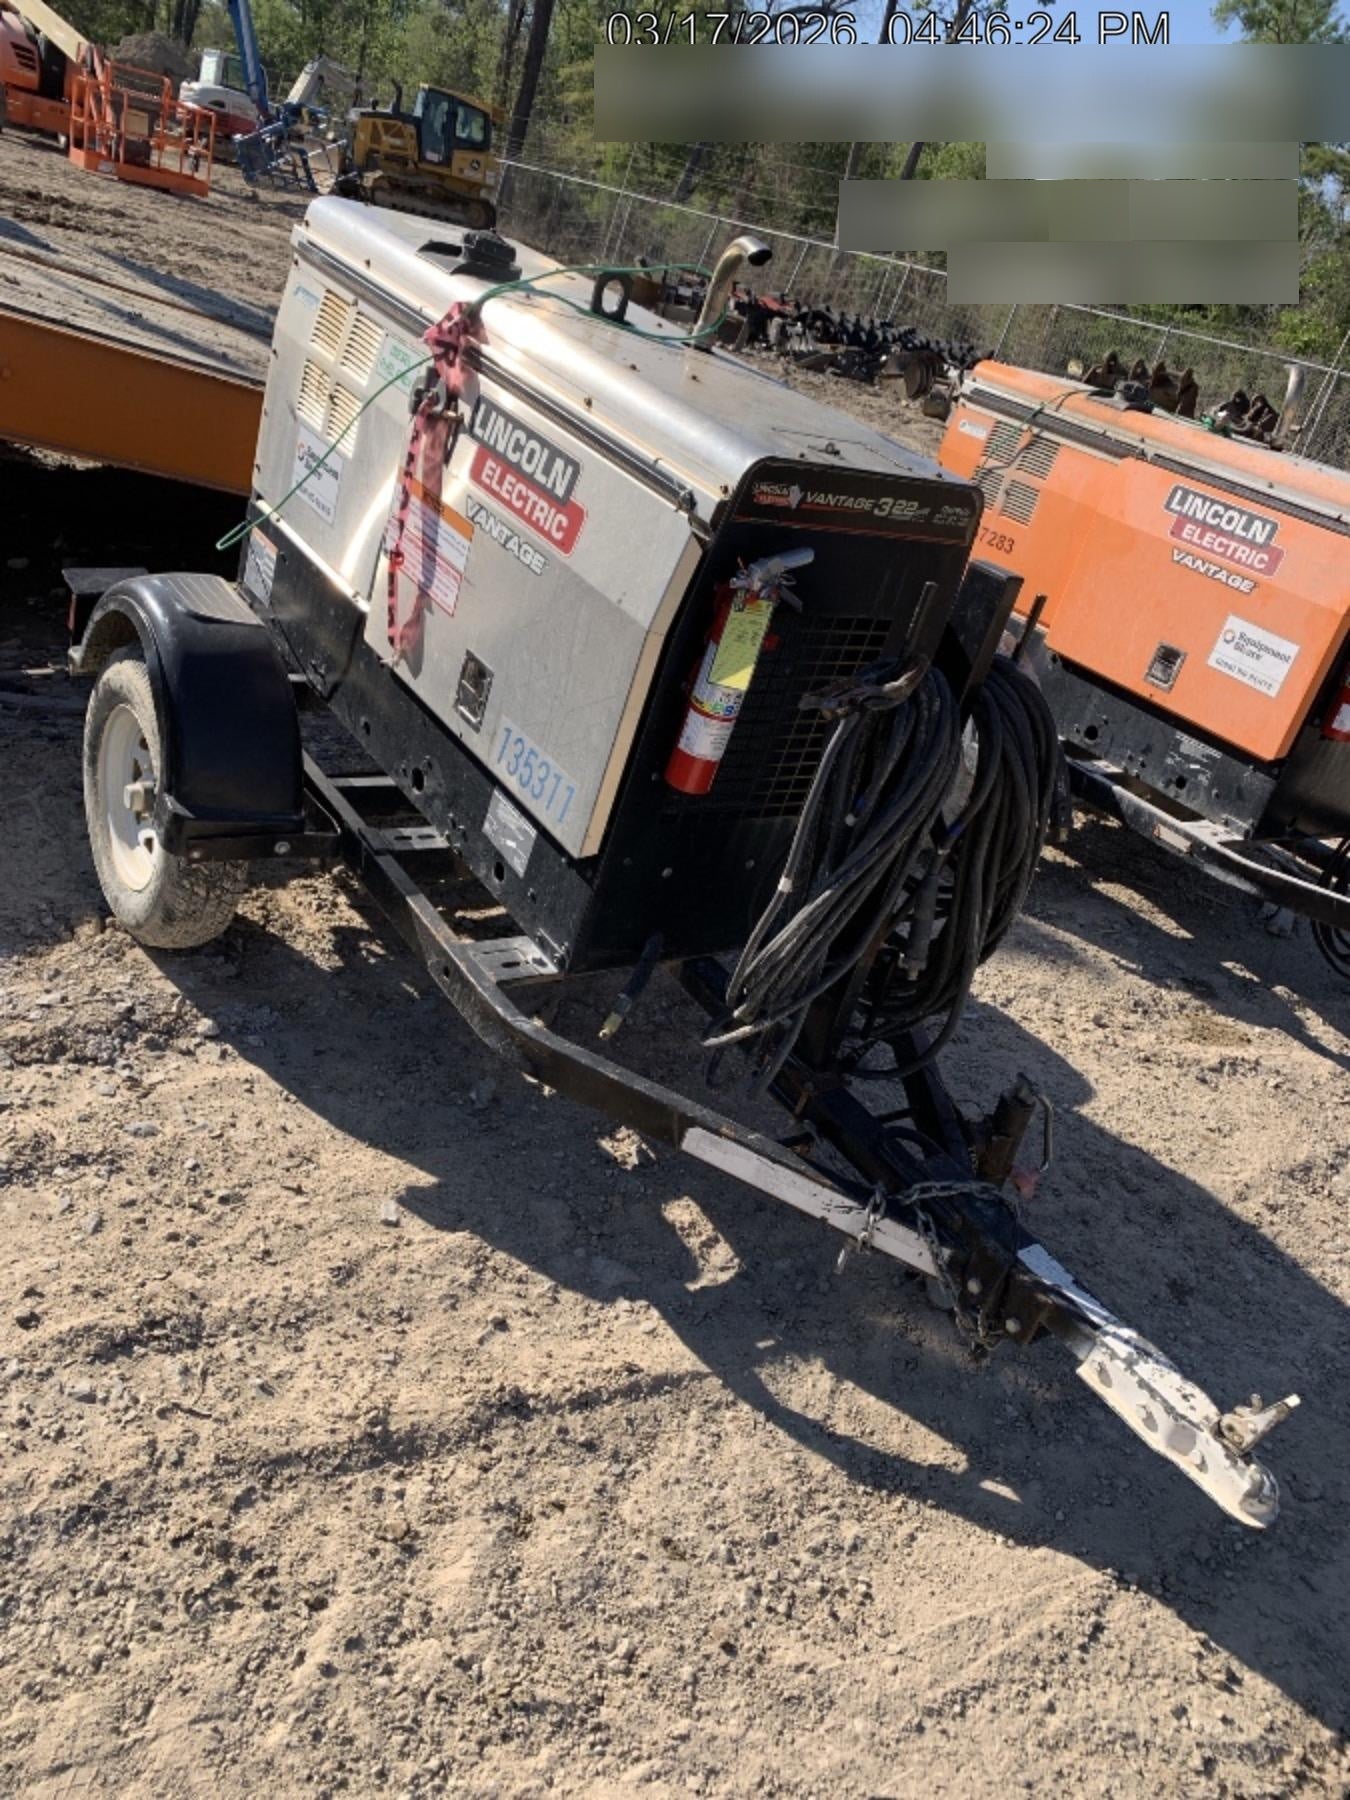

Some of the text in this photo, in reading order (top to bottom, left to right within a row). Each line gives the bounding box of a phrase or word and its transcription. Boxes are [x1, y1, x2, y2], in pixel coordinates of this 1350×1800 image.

[472, 402, 574, 499] LINCOLN
[480, 457, 569, 541] ELECTRIC
[805, 491, 875, 511] VANTAGE
[1169, 488, 1272, 546] LINCOLN
[466, 494, 549, 576] VANTAGE
[1181, 523, 1269, 569] ELECTRIC
[1171, 547, 1258, 594] VANTAGE
